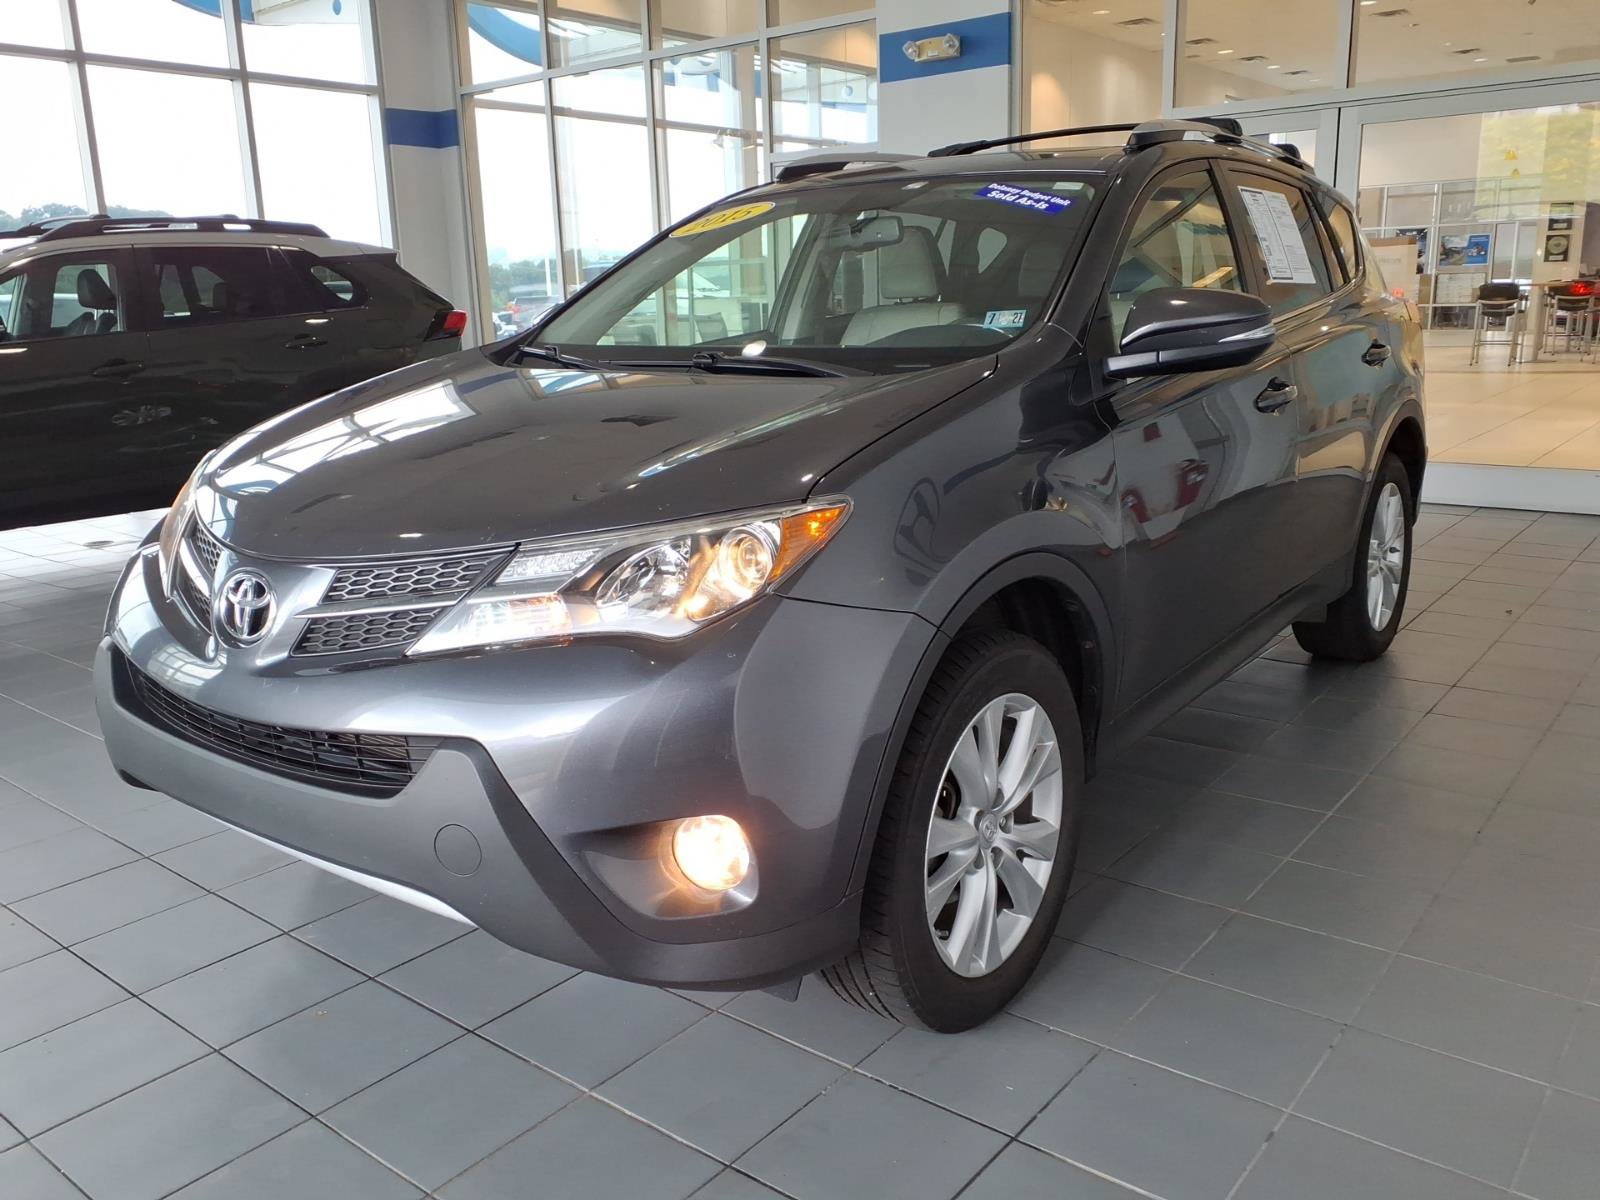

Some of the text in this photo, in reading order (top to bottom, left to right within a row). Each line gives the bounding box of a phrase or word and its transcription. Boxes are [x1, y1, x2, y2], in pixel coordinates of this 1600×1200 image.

[987, 190, 1019, 202] Sold
[1020, 189, 1052, 201] Budget
[1050, 196, 1071, 206] Unit
[682, 204, 765, 233] 2015
